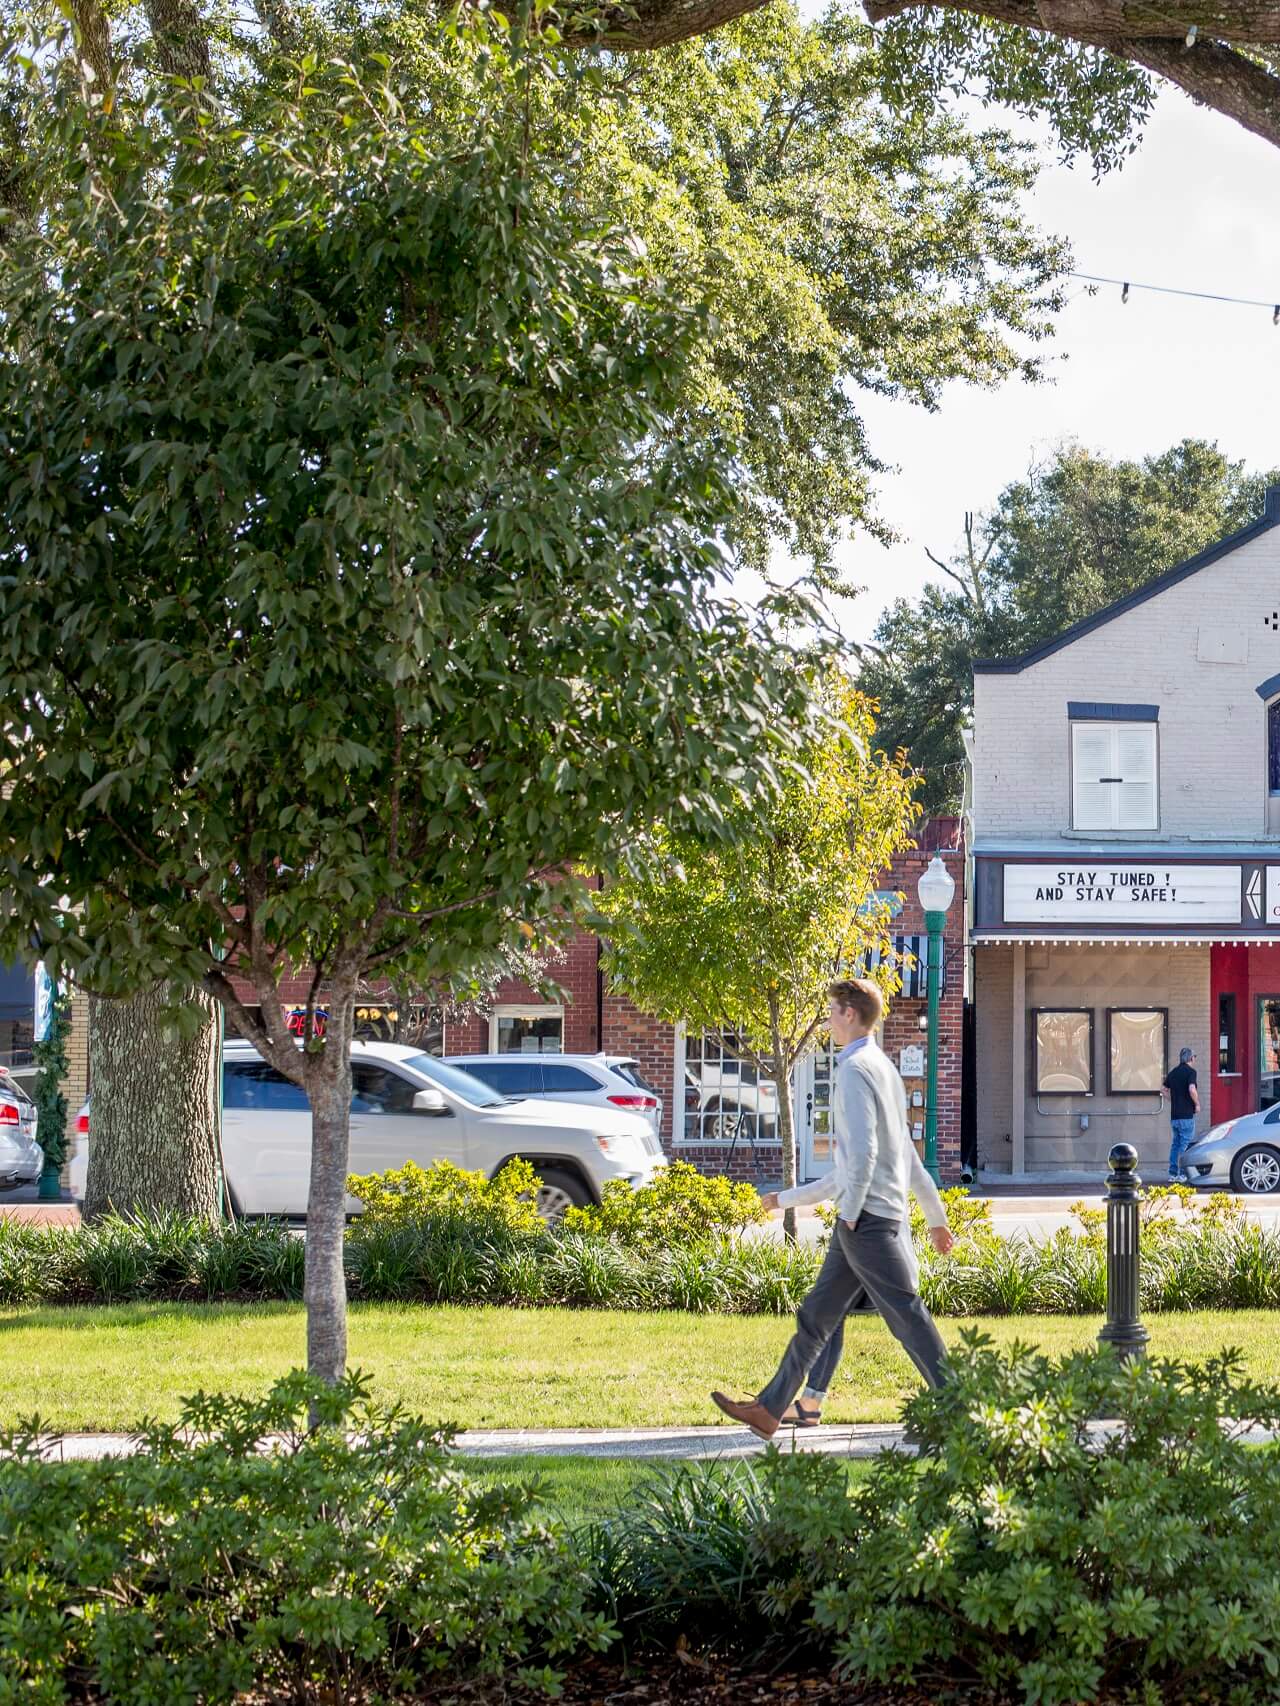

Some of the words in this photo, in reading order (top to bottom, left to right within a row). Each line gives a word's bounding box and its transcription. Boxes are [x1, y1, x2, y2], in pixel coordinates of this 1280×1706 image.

[1057, 872, 1097, 886] STAY
[1110, 872, 1155, 886] TUNED
[1035, 887, 1064, 901] AND
[1076, 887, 1115, 901] STAY
[1131, 888, 1177, 902] SAFE!
